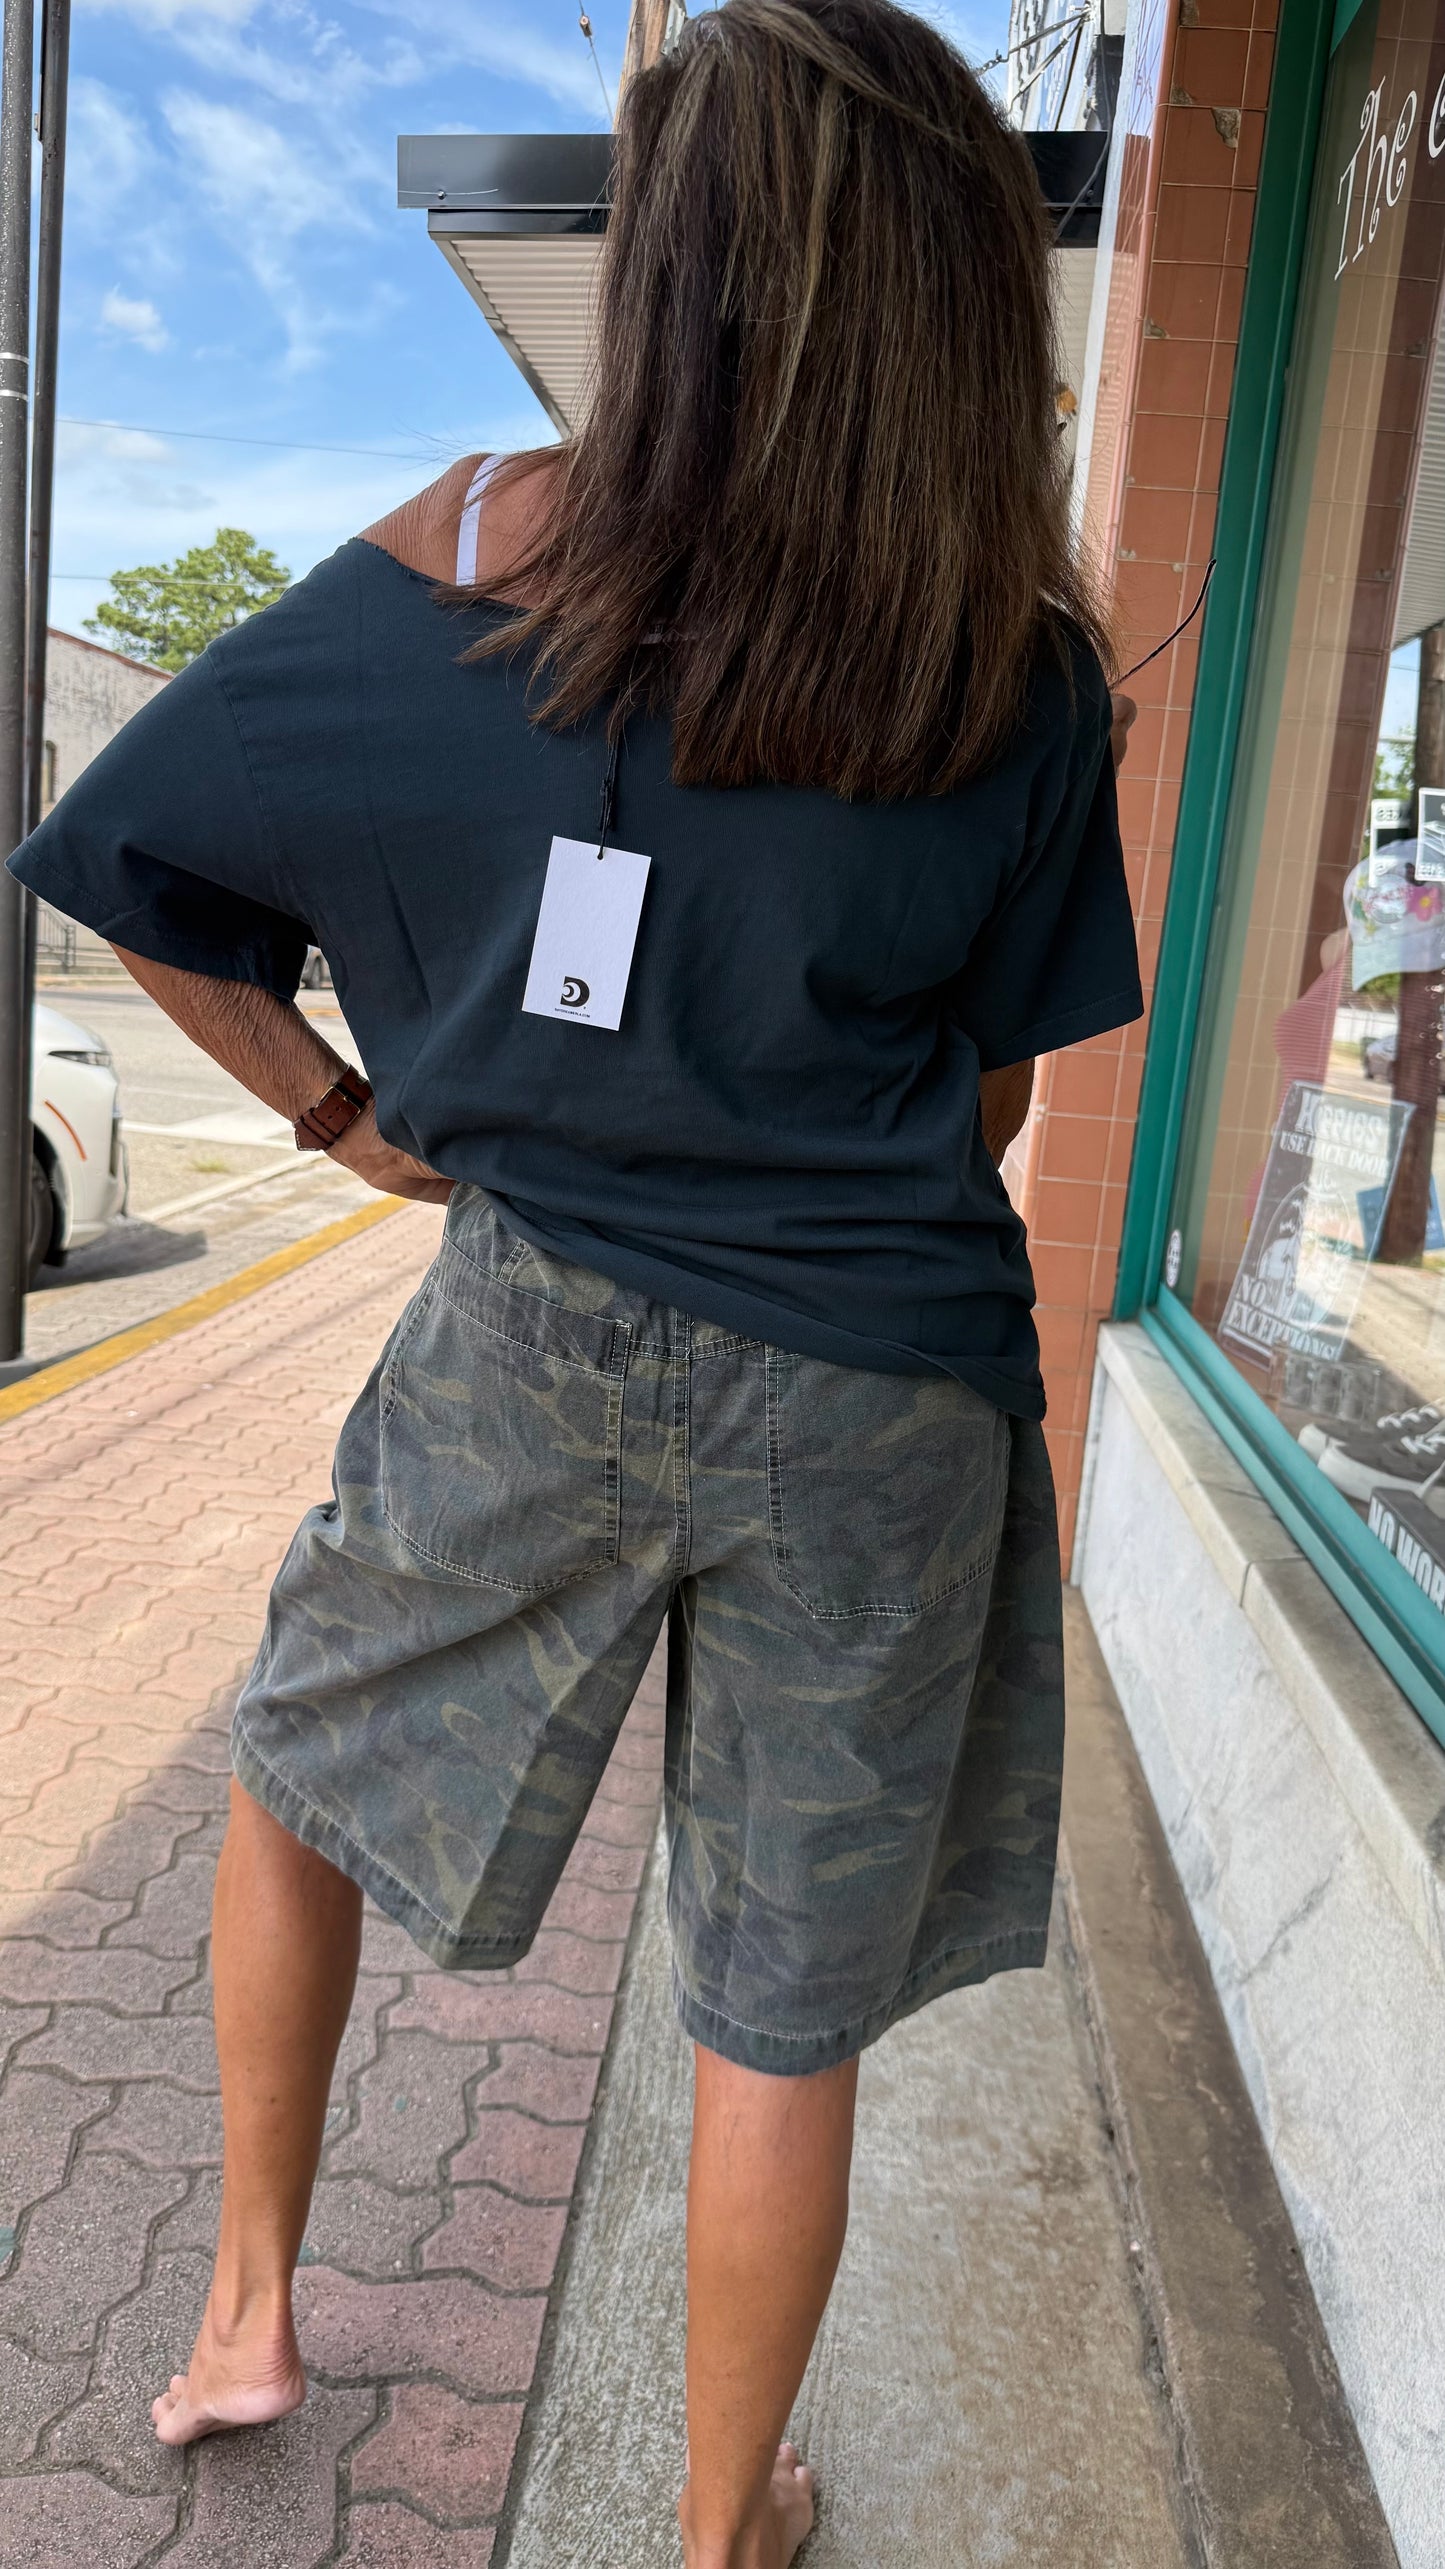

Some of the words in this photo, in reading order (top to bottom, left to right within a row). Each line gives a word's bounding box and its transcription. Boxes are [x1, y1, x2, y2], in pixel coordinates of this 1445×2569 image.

[1334, 76, 1417, 281] The
[1280, 1131, 1308, 1153] USE
[1235, 1274, 1267, 1307] NO
